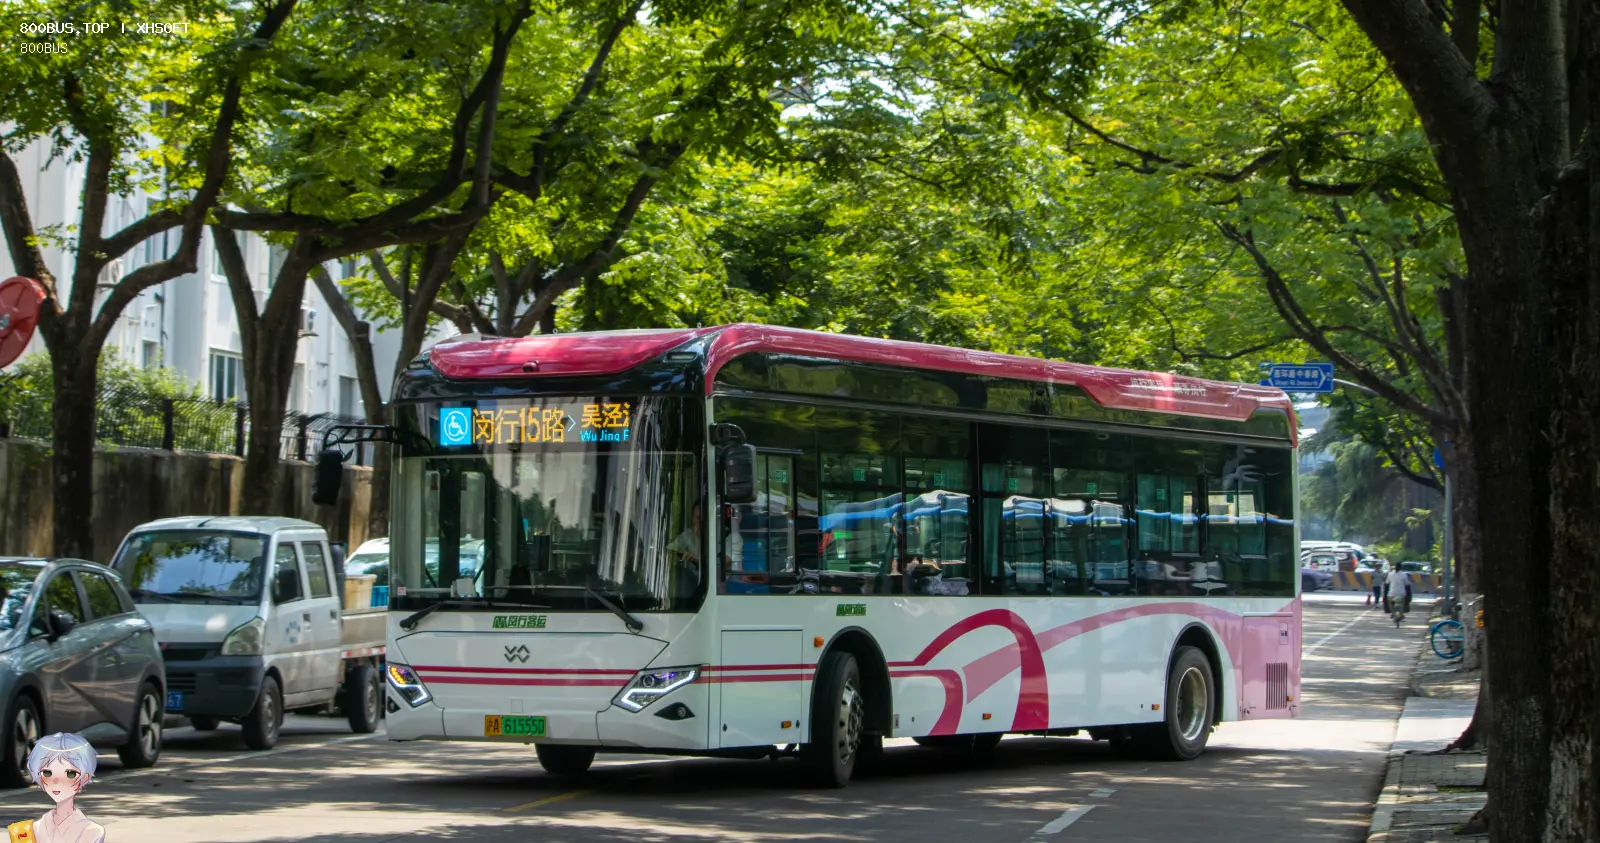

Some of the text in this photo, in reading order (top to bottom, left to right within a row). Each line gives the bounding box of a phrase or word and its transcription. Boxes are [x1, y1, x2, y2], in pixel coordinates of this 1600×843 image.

[472, 407, 565, 444] 闵行15路
[579, 429, 597, 442] Wu
